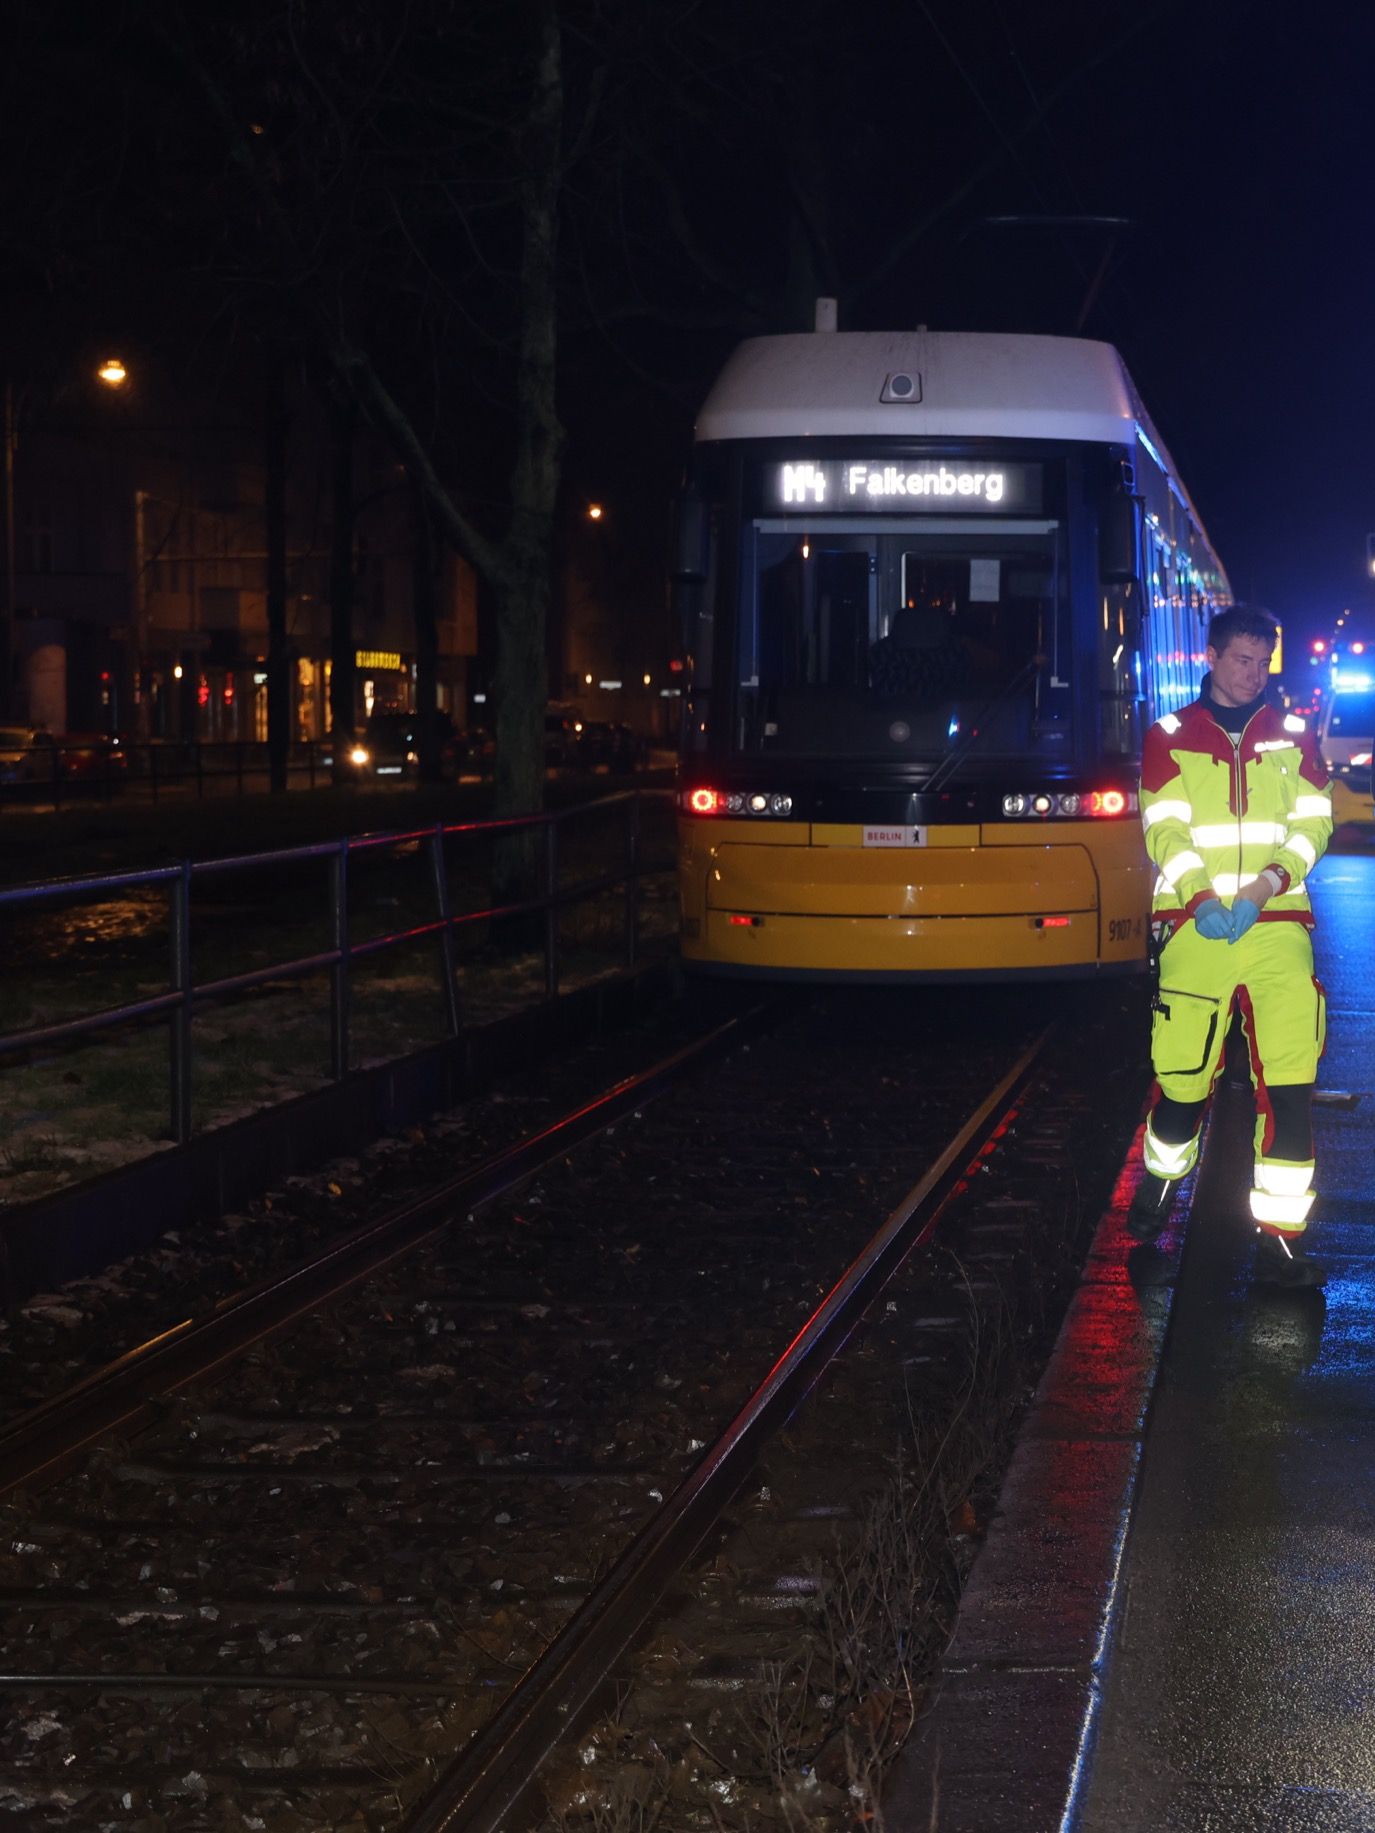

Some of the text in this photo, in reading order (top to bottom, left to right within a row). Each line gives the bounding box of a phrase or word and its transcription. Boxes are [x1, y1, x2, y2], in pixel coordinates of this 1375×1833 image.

[783, 465, 1004, 502] M4 Falkenberg
[867, 831, 902, 841] BERLIN
